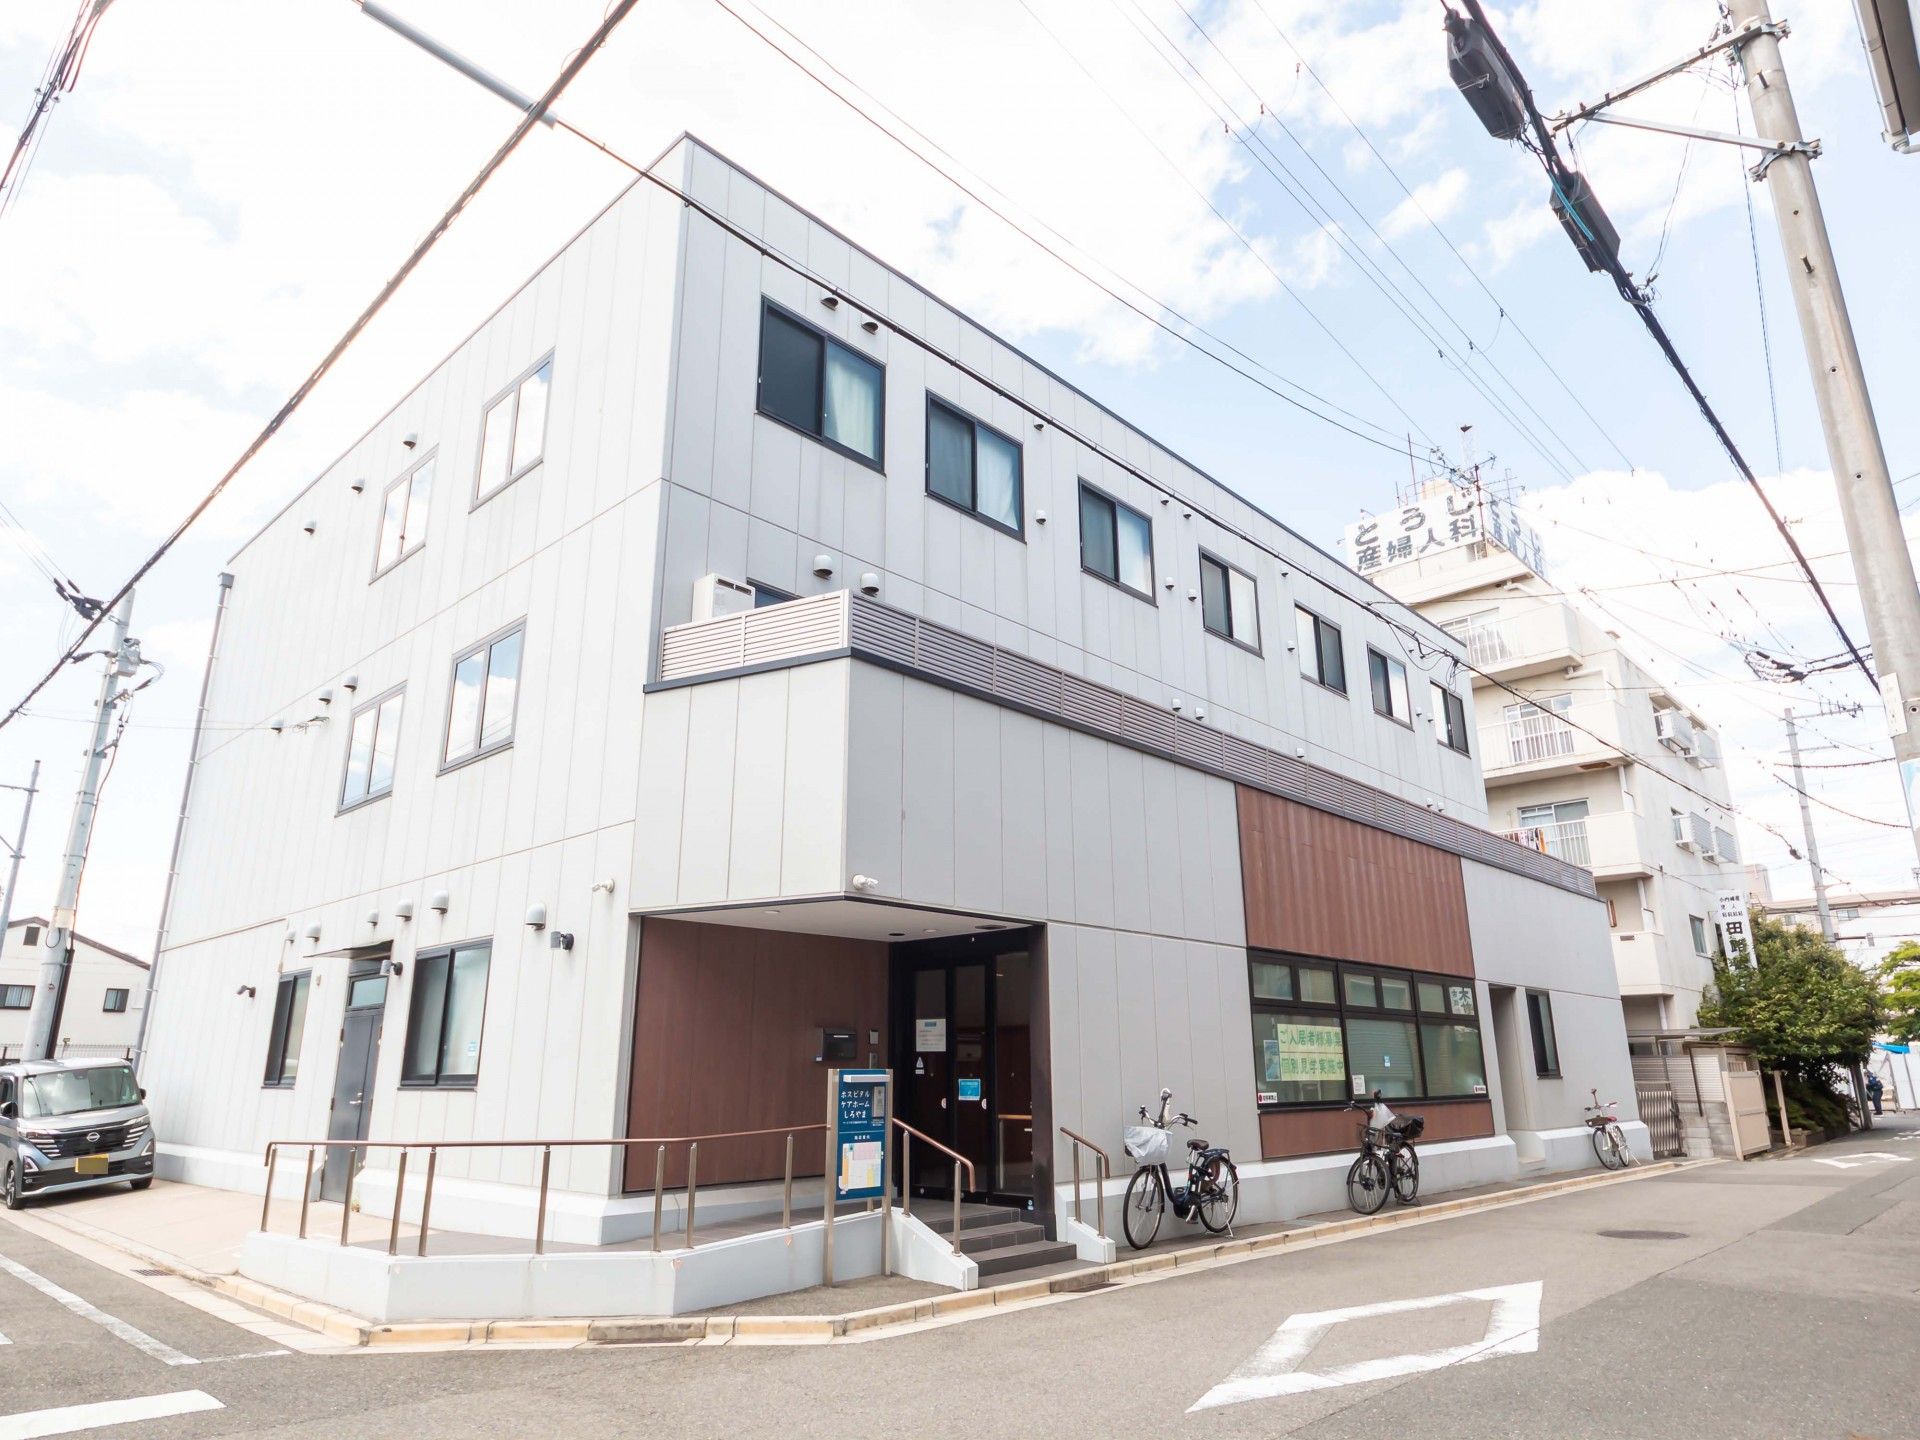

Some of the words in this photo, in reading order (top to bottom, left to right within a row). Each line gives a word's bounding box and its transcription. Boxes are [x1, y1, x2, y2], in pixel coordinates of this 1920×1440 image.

[1355, 489, 1475, 546] とうじ
[1356, 515, 1477, 573] 産婦人科
[841, 1090, 870, 1098] ホスピタル
[844, 1110, 866, 1118] しろやま
